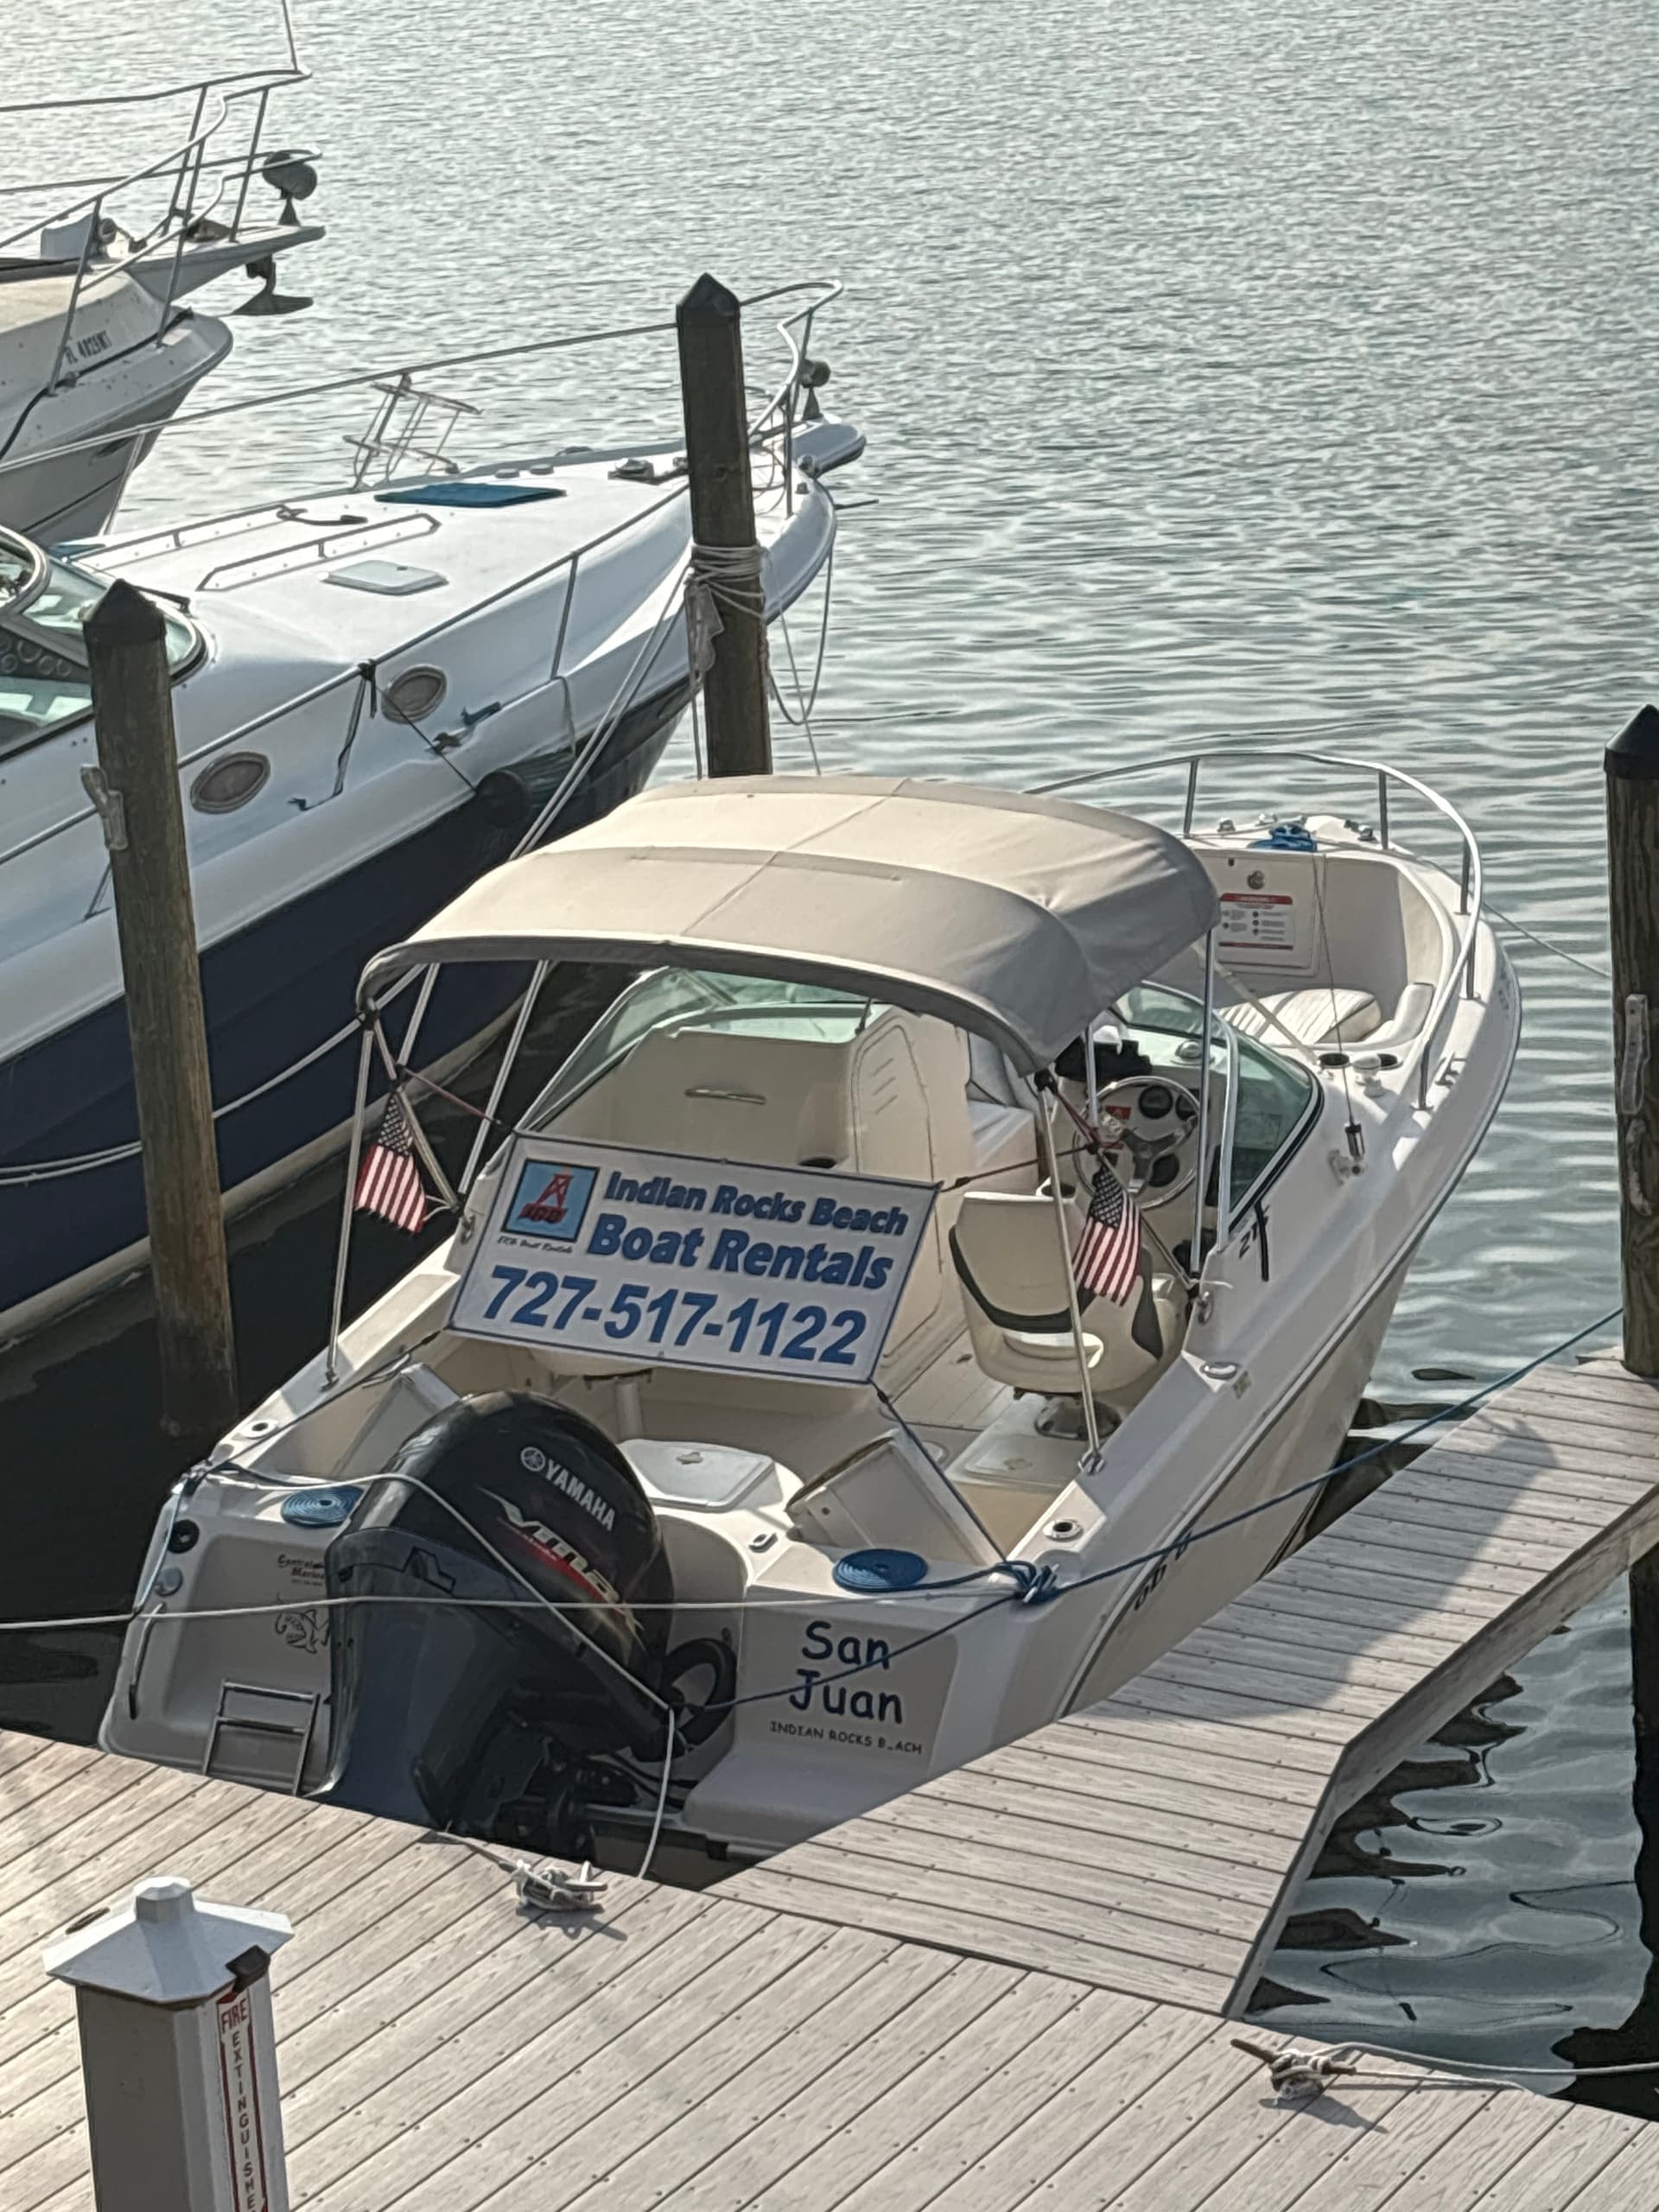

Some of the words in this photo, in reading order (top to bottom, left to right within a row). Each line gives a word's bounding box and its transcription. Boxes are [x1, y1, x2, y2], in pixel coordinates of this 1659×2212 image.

[605, 1171, 707, 1211] Indian
[710, 1185, 806, 1223] Rocks
[809, 1197, 909, 1236] Beach
[587, 1212, 703, 1268] Boat
[709, 1228, 893, 1290] Rentals
[482, 1264, 868, 1366] 727-517-1122
[543, 1458, 616, 1532] YAMAHA
[802, 1620, 891, 1670] San
[789, 1668, 903, 1725] Juan
[770, 1720, 824, 1738] INDIAN
[828, 1730, 873, 1747] ROCKS
[878, 1737, 923, 1755] BACH
[221, 1998, 249, 2034] FIRE
[231, 2031, 257, 2212] EXTINGUISHE
